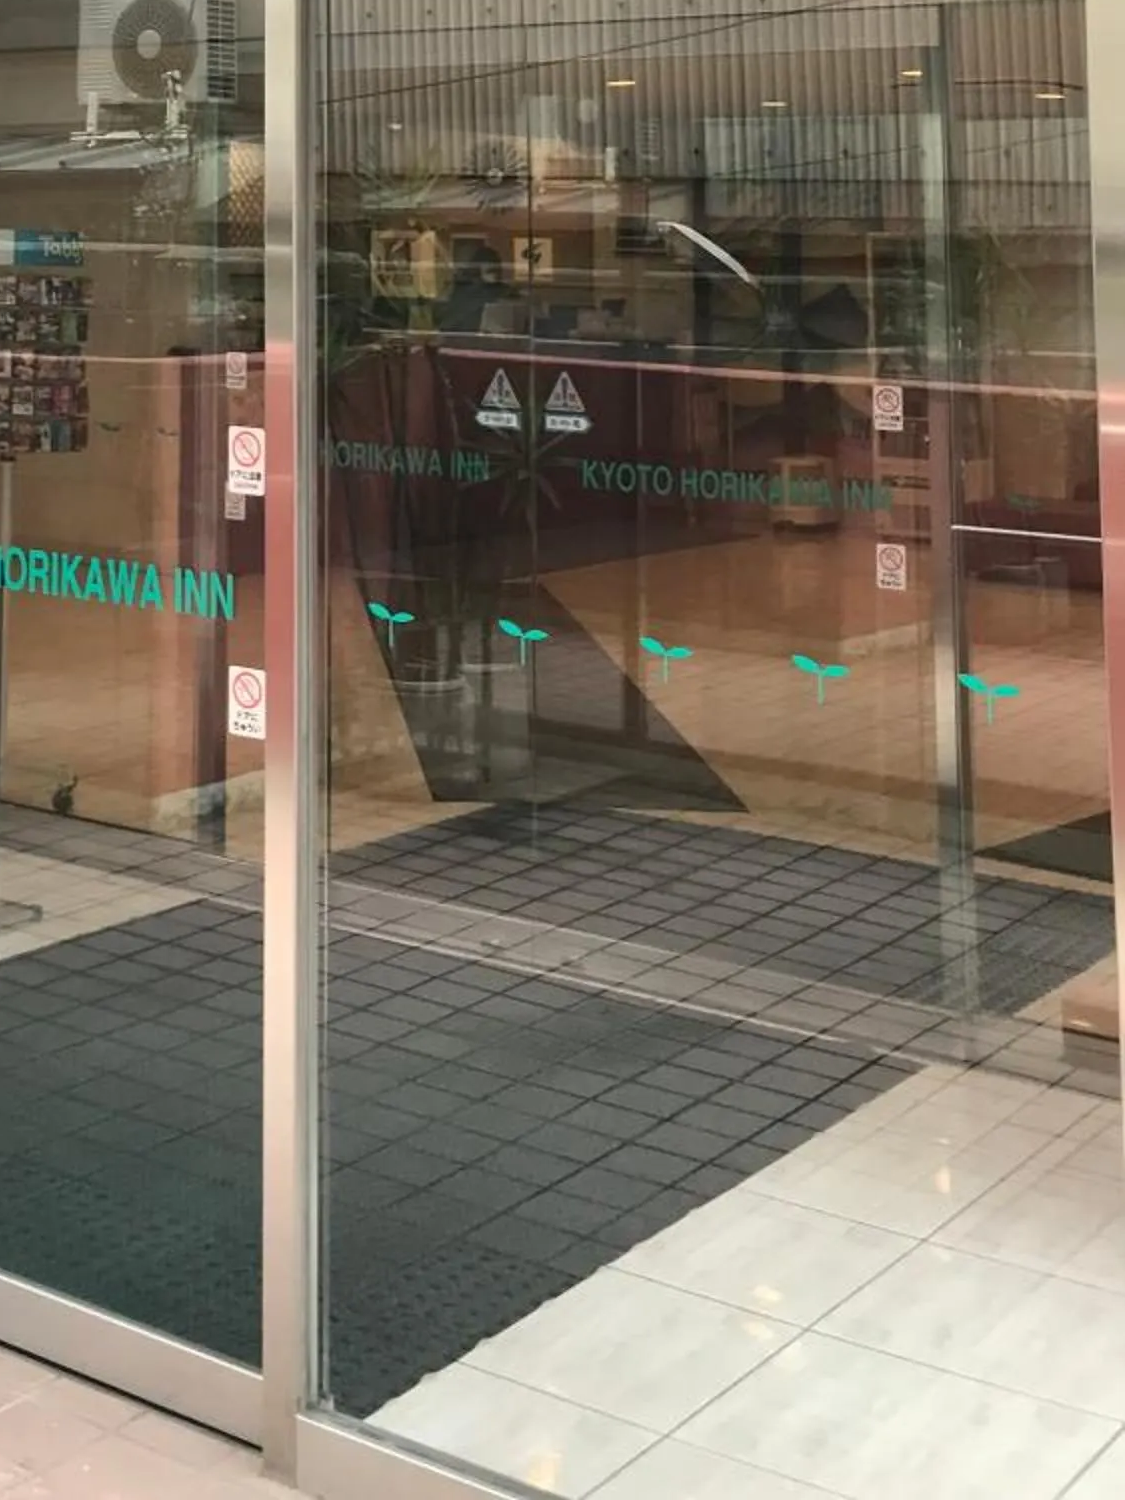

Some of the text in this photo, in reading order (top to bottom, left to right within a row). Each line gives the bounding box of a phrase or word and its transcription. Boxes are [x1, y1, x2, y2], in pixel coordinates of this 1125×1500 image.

[450, 448, 491, 481] INN
[581, 459, 893, 512] KYOTO HORIKAWA INN
[174, 568, 235, 621] INN
